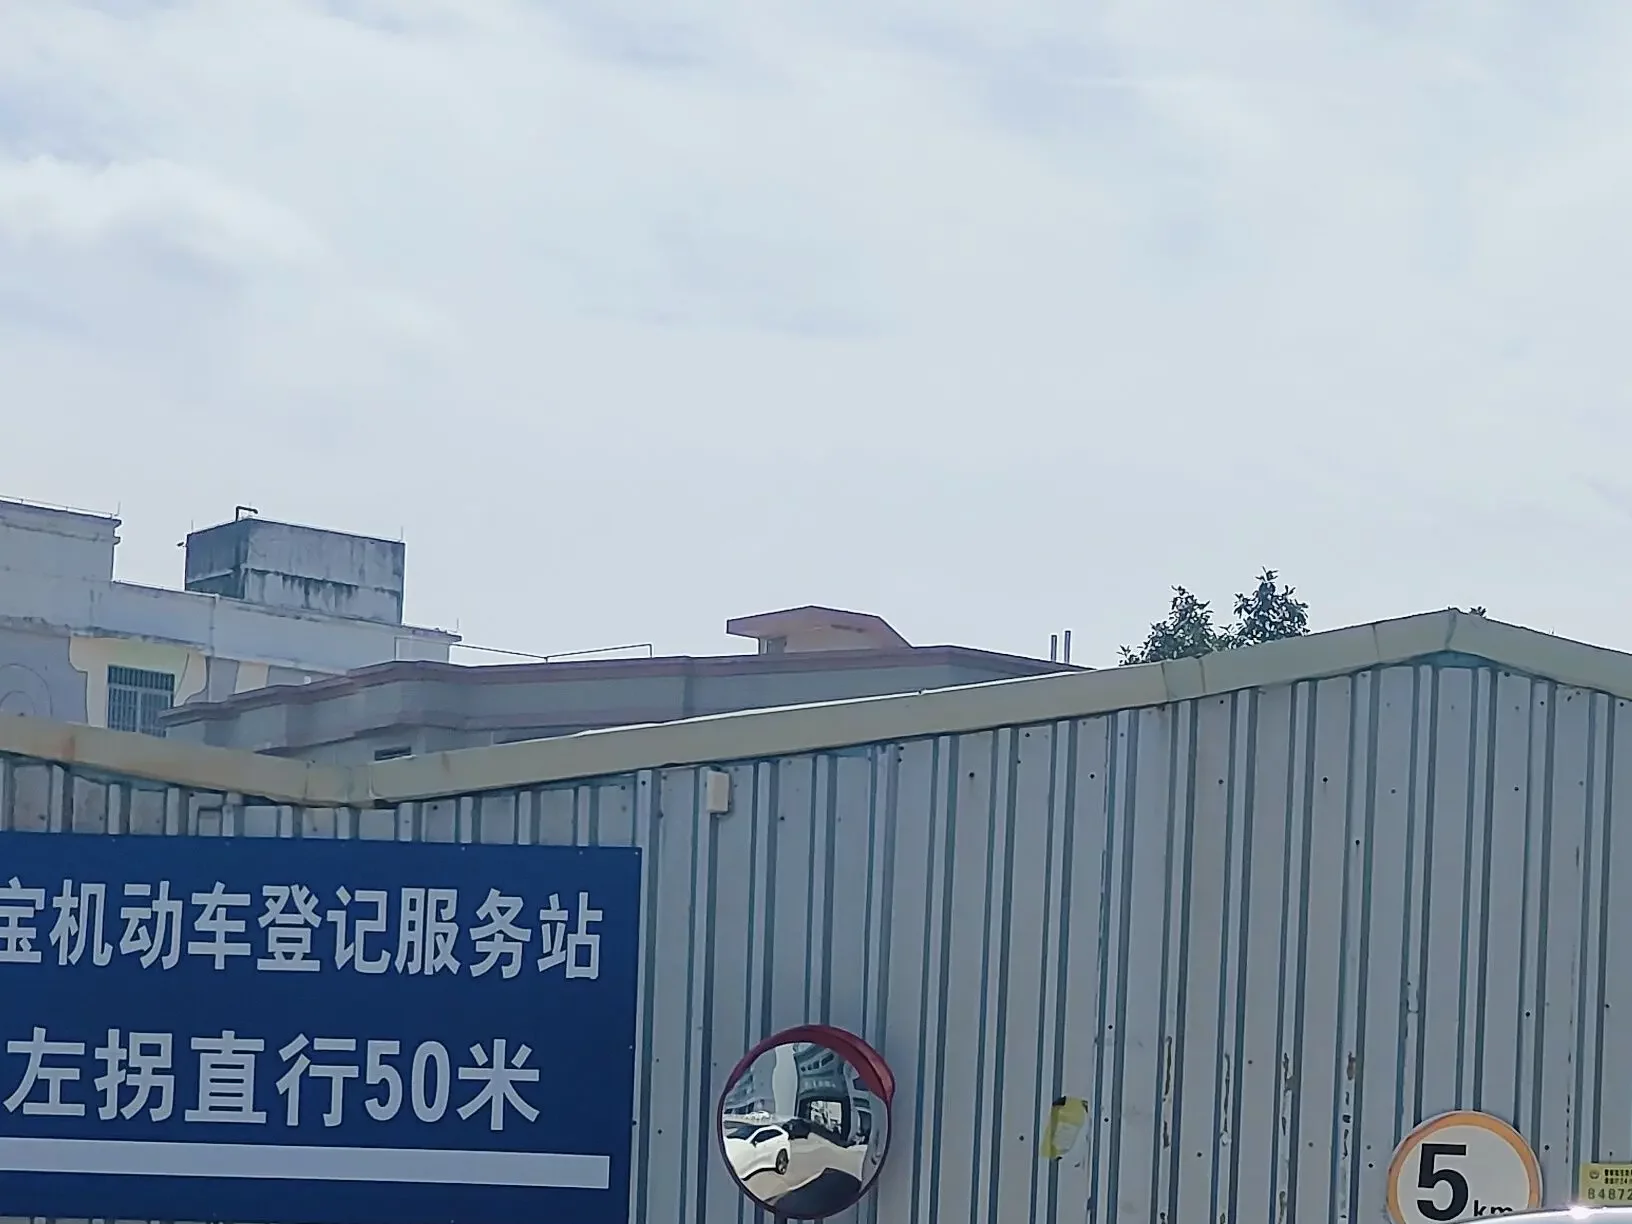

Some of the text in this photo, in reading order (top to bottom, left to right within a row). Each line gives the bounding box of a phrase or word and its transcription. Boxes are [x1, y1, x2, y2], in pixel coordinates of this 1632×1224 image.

[0, 877, 604, 980] 宝机动车登记服务站
[5, 1026, 541, 1131] 左拐直行50米
[1416, 1143, 1469, 1221] 5
